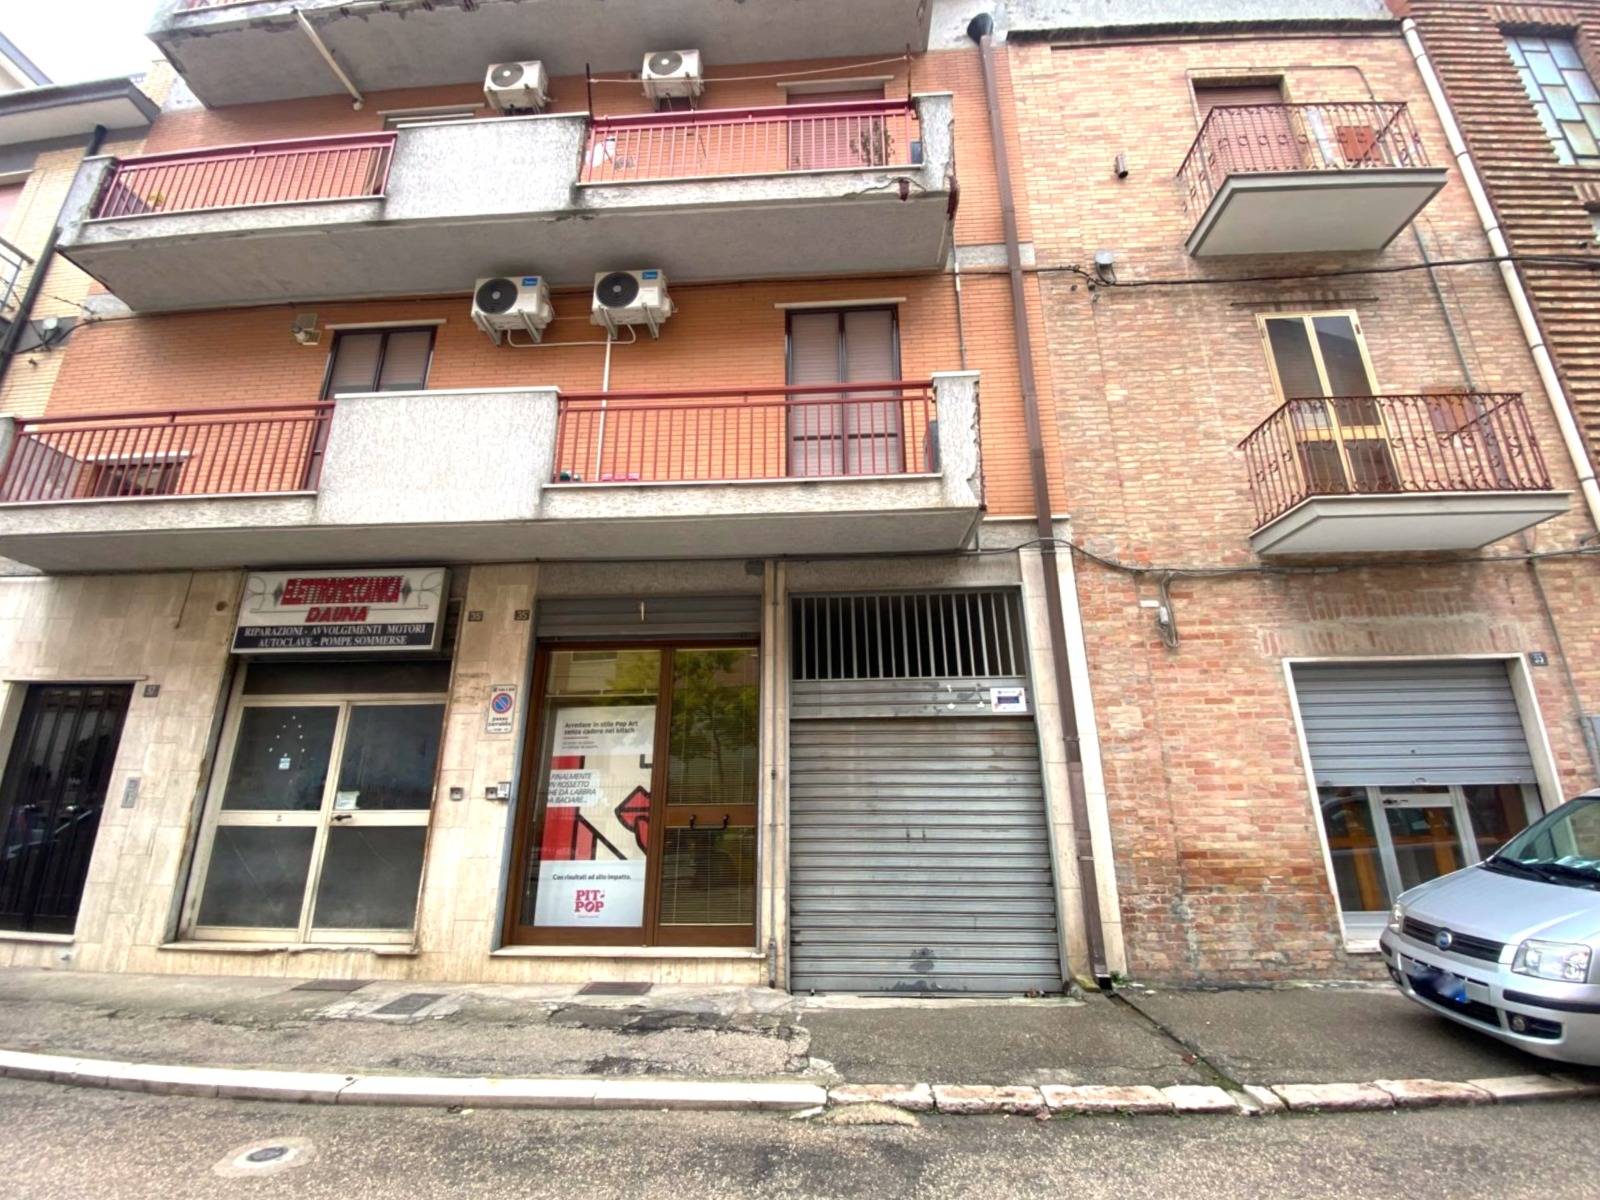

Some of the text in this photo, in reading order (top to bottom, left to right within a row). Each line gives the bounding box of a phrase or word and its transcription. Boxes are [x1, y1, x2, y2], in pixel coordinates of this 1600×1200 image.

[305, 606, 369, 623] DAUNA
[244, 626, 303, 637] RIPARAZIONI
[311, 625, 382, 635] AVVOLGIMENTI
[387, 624, 426, 634] MOTORI
[258, 637, 313, 648] AUTOCLAVE
[320, 637, 353, 647] POMPE
[354, 635, 407, 646] SOMMERSE
[570, 788, 596, 796] LABBRA
[574, 901, 604, 912] POP
